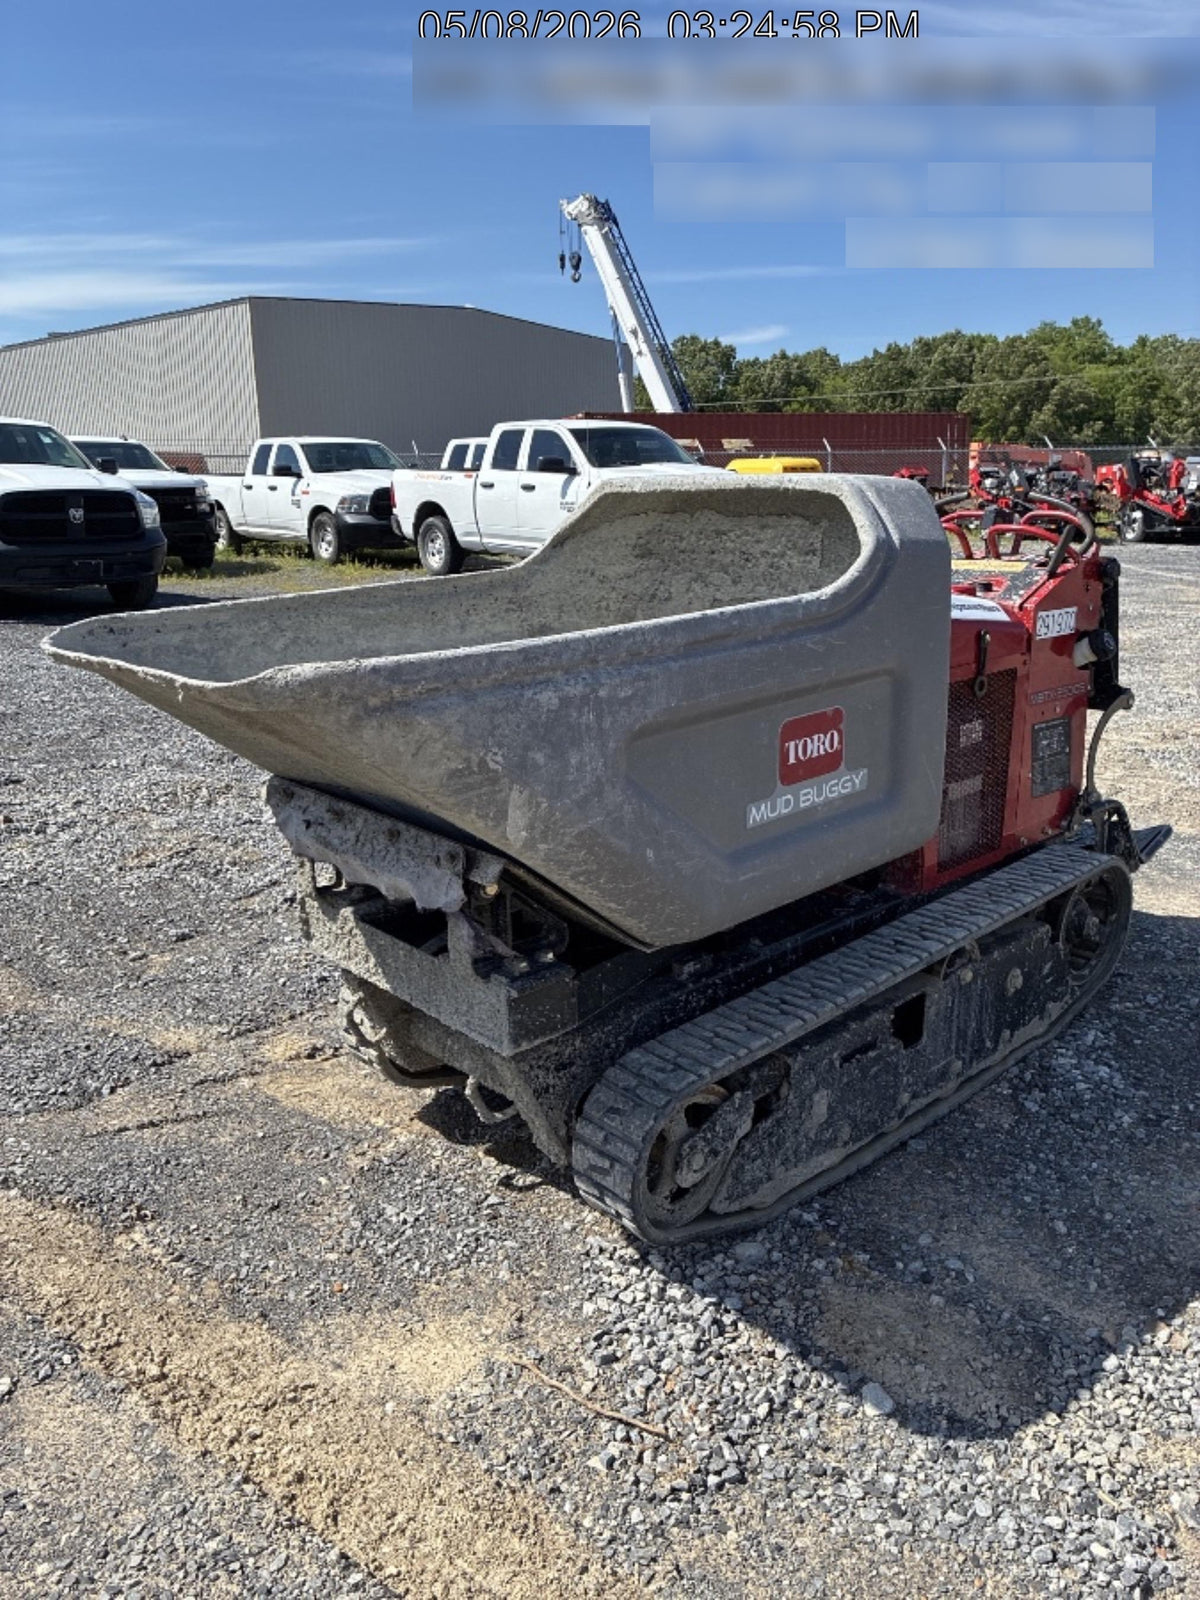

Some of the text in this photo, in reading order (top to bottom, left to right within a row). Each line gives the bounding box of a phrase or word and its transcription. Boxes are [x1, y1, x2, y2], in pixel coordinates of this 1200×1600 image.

[784, 729, 840, 766] TORO
[749, 770, 865, 825] MUD BUGGY
